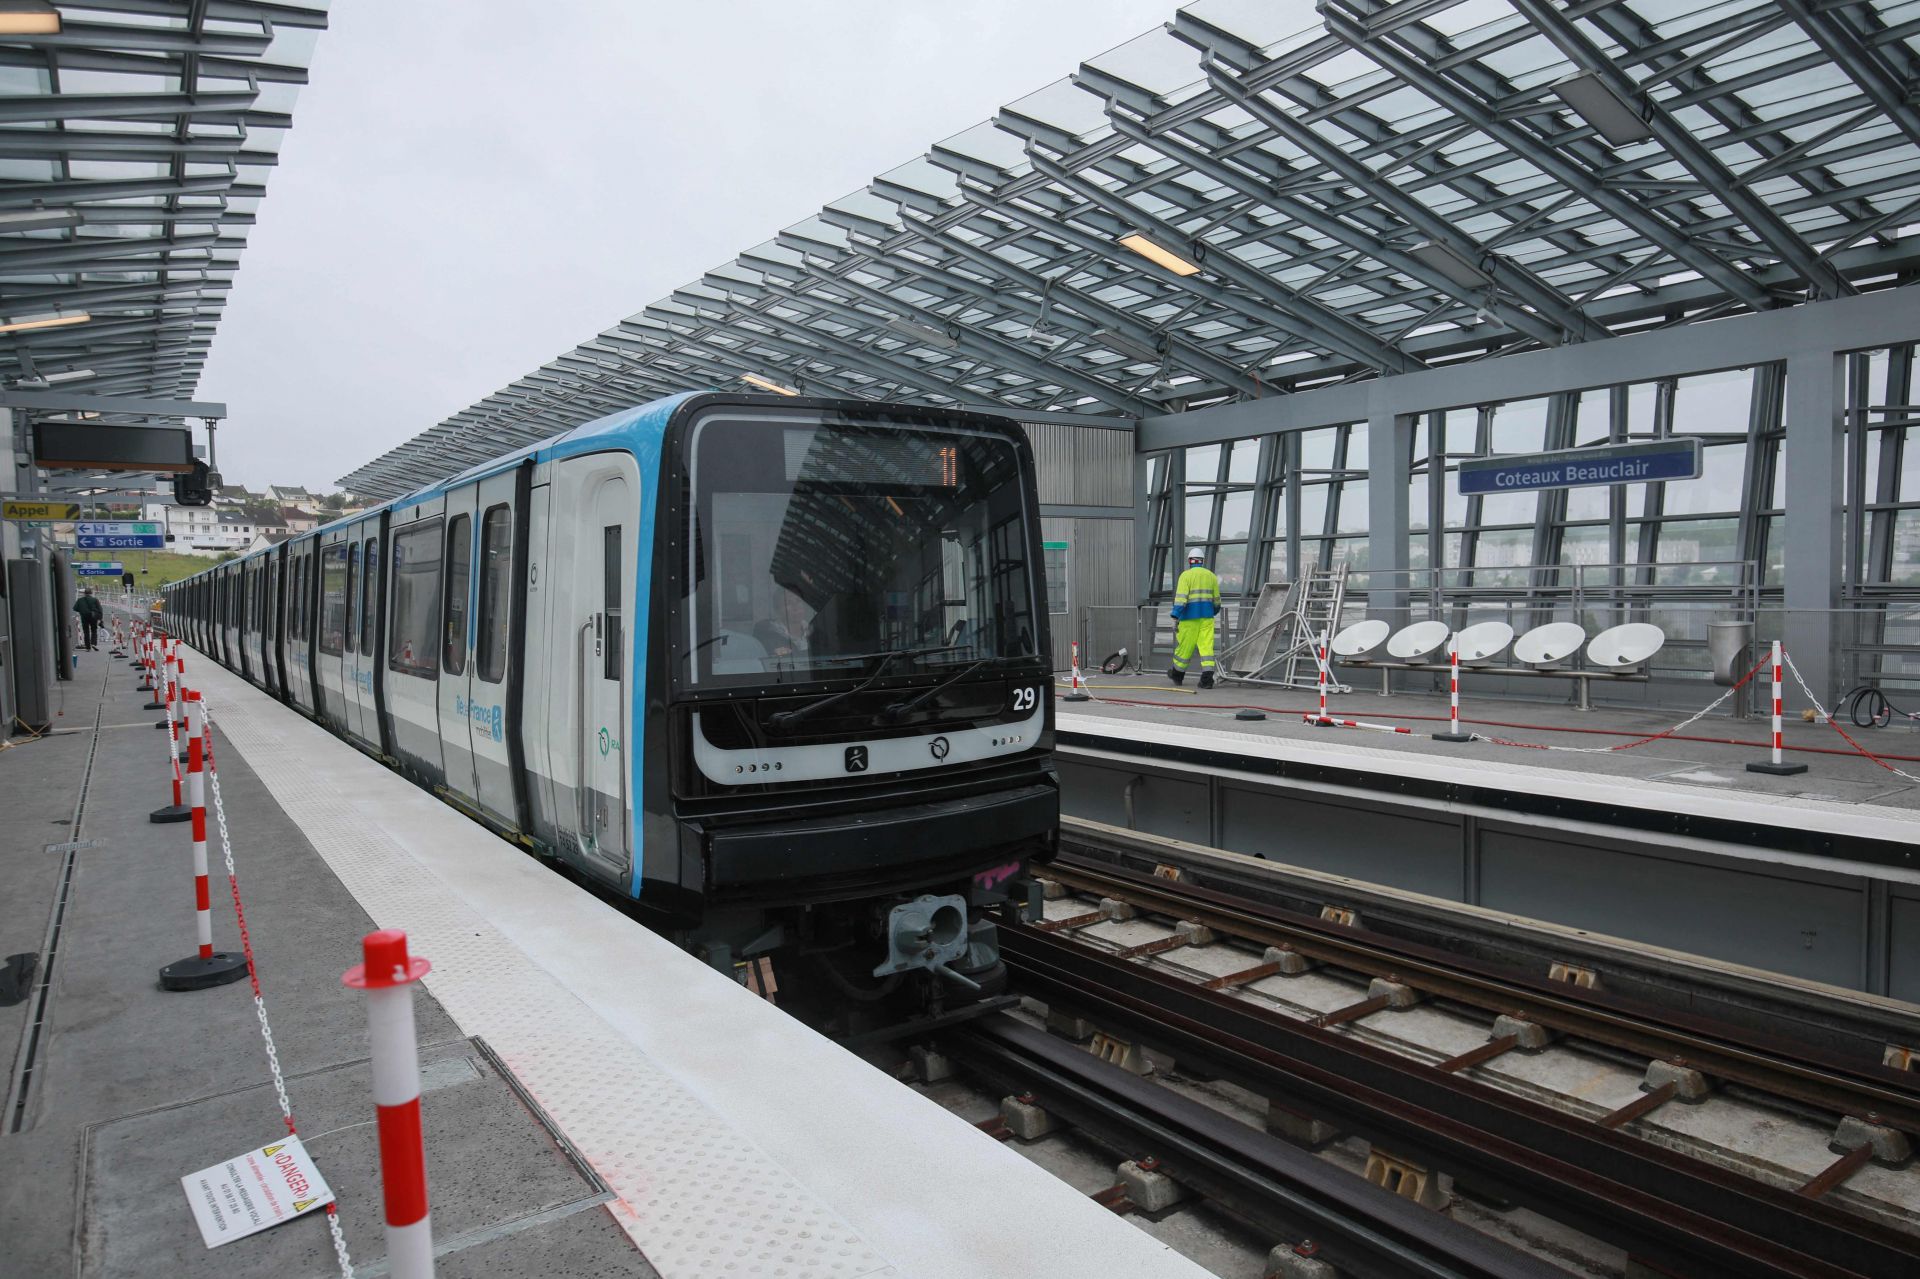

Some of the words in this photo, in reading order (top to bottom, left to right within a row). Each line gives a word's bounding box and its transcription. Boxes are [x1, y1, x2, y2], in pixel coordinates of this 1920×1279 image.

[938, 447, 956, 486] 11
[1495, 469, 1560, 487] Coteaux
[1566, 459, 1650, 481] Beauclair
[8, 504, 49, 518] Appel
[109, 537, 144, 546] Sortie
[1013, 686, 1035, 711] 29
